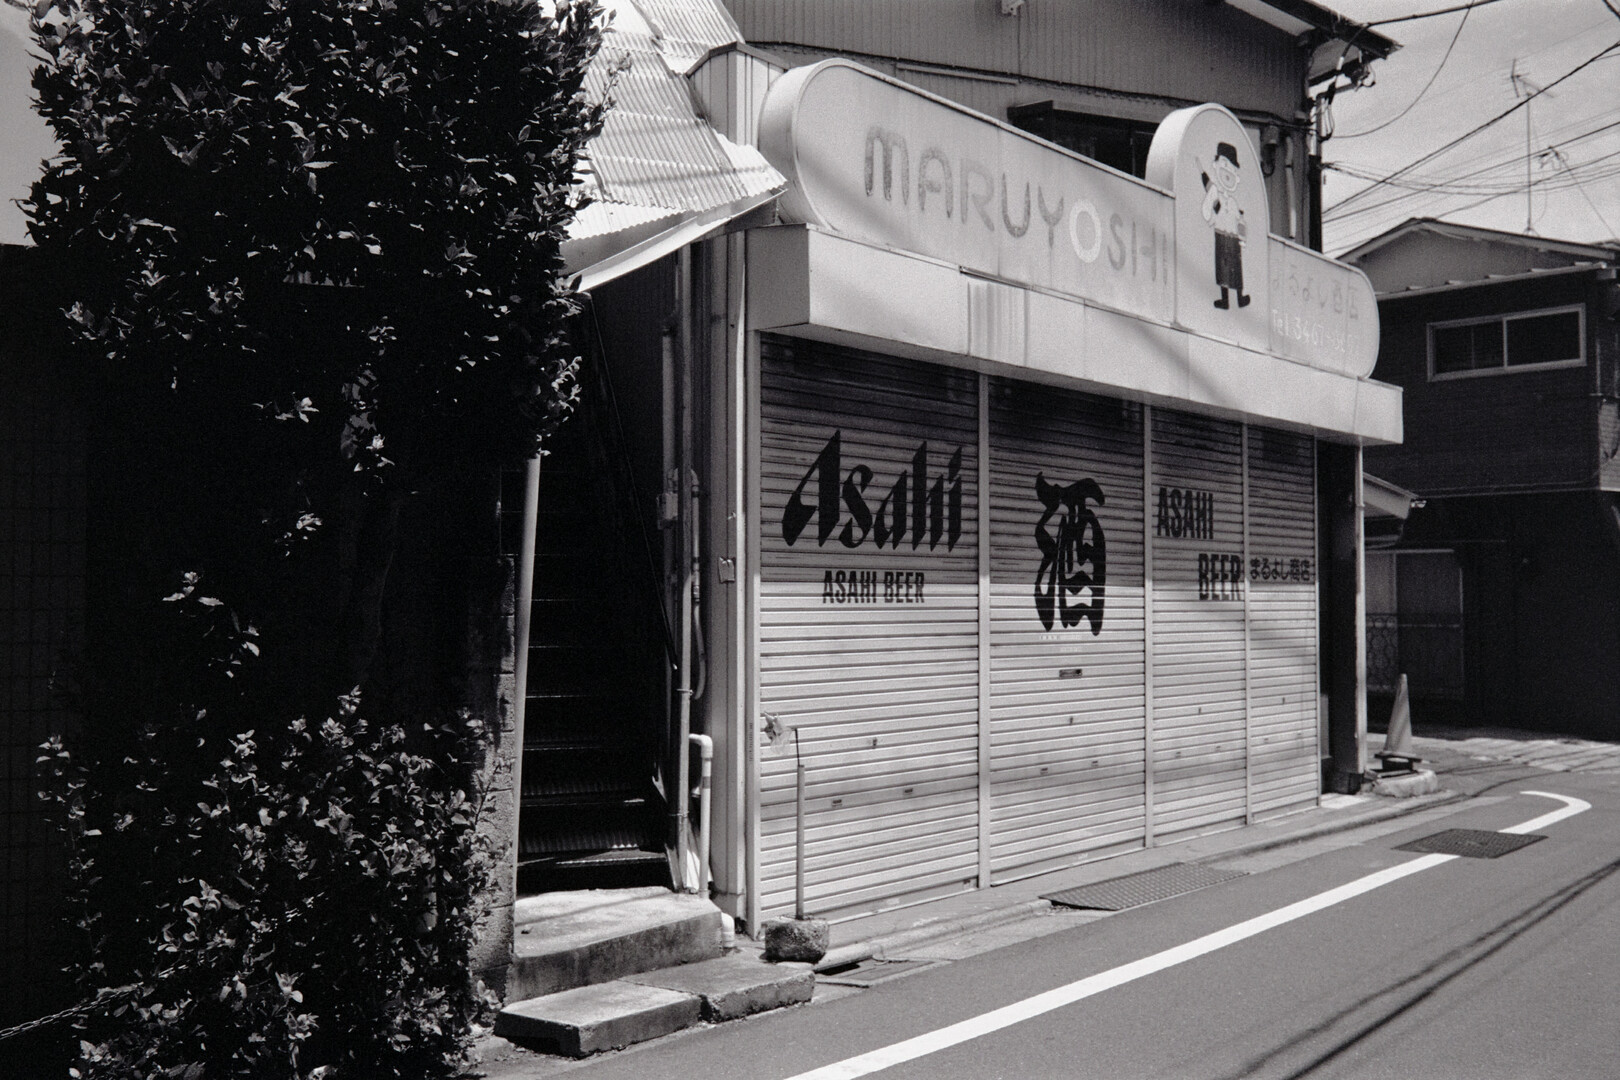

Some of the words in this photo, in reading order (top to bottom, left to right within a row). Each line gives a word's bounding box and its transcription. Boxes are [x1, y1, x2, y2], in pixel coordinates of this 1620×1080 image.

[863, 126, 1168, 286] MARUYOSHI
[782, 430, 963, 552] Asahi
[1157, 487, 1214, 540] ASAHI
[1035, 471, 1106, 637] 酒
[1199, 553, 1241, 600] BEER
[1250, 558, 1311, 582] まるよし商店
[822, 570, 878, 604] ASAHI
[883, 571, 925, 604] BEER
